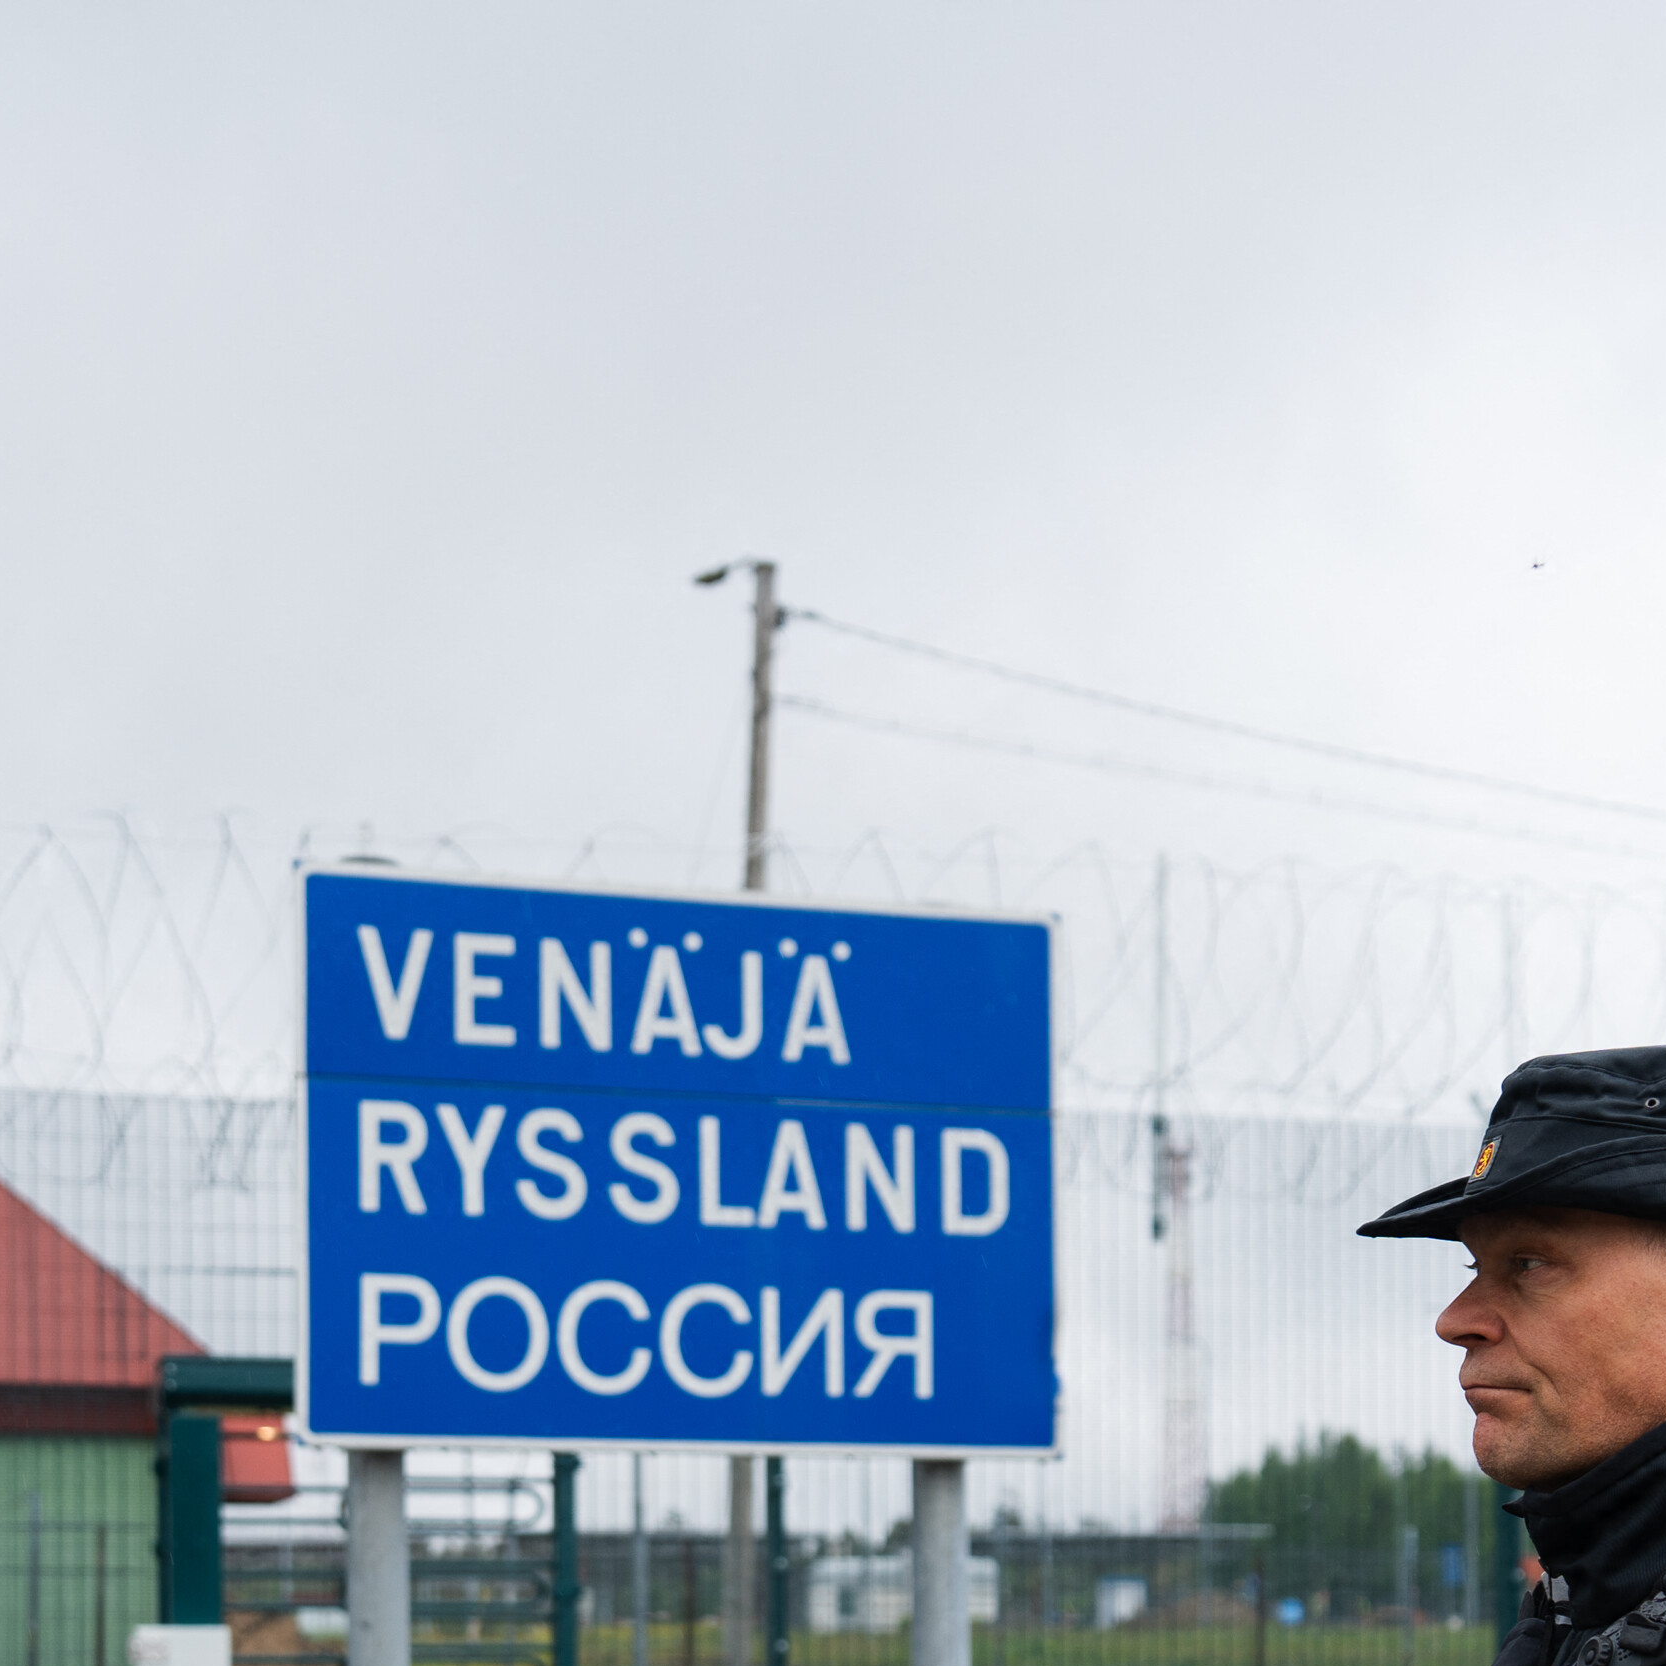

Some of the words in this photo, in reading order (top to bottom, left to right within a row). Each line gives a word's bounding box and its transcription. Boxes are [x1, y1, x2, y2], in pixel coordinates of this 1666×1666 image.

[356, 924, 852, 1065] VENÄJÄ
[357, 1099, 1010, 1236] RYSSLAND
[358, 1273, 934, 1400] РОССИЯ
